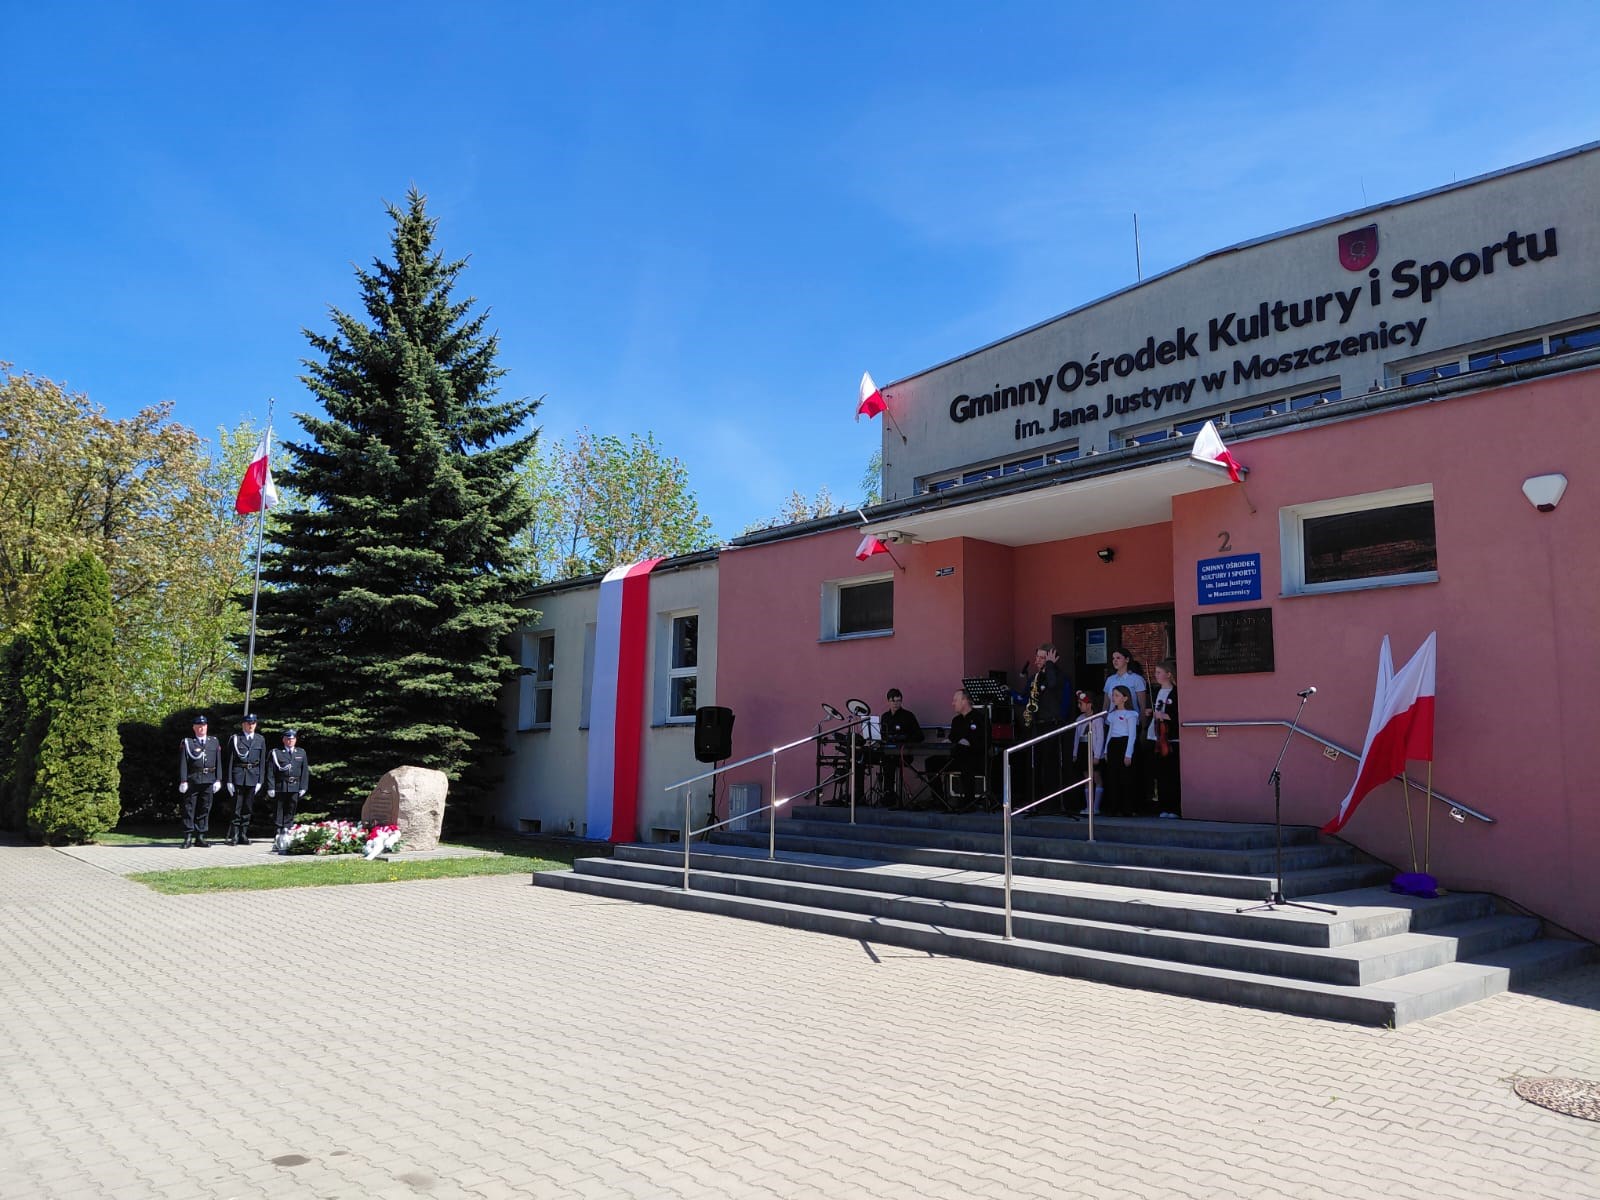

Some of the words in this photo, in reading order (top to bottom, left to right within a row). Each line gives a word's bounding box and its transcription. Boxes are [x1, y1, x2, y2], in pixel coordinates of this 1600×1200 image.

[950, 373, 1053, 422] Gminny
[1057, 326, 1199, 392] Ośrodek
[1208, 286, 1361, 353] Kultury
[1369, 268, 1380, 306] i
[1392, 228, 1557, 302] Sportu
[1015, 419, 1044, 440] im.
[1050, 403, 1099, 431] Jana
[1103, 378, 1195, 417] Justyny
[1202, 369, 1226, 389] w
[1234, 318, 1426, 384] Moszczenicy
[1218, 531, 1232, 552] 2
[1202, 564, 1225, 572] GMINNY
[1226, 560, 1255, 569] OŚRODEK
[1201, 572, 1226, 581] KULTURY
[1230, 579, 1251, 587] Justyny
